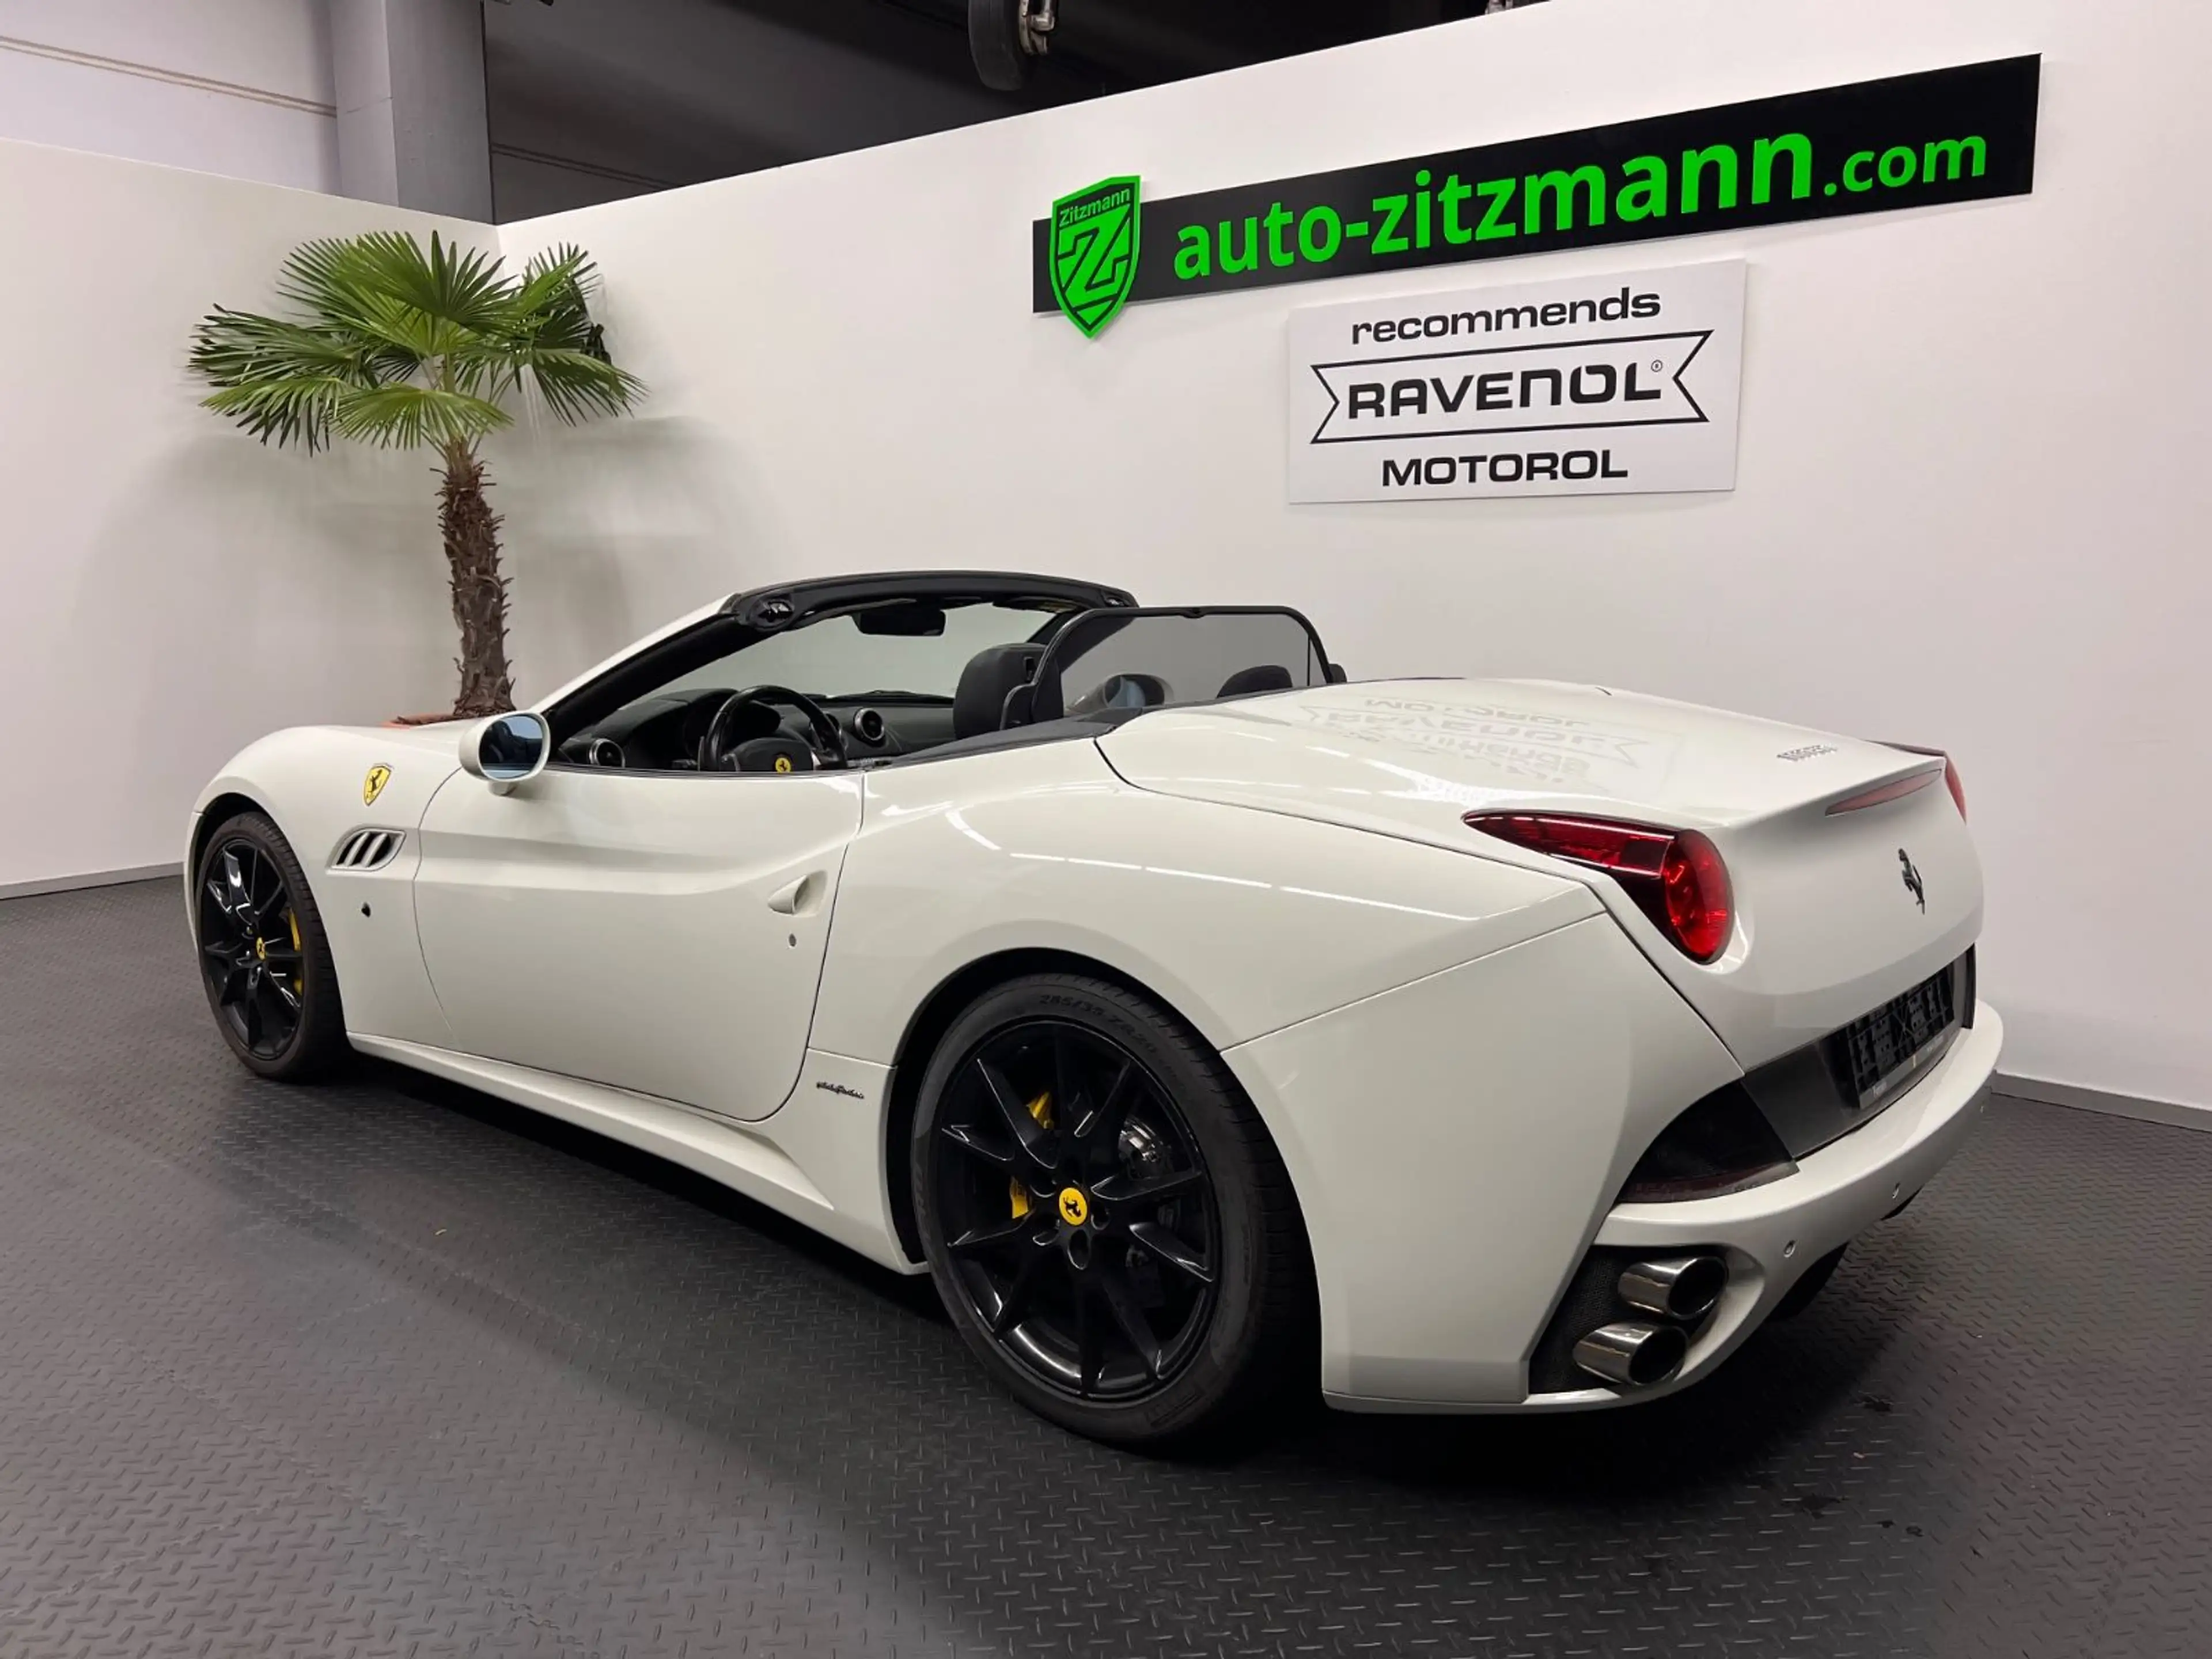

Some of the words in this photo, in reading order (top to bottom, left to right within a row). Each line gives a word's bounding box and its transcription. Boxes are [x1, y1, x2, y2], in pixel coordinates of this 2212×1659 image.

[1059, 188, 1130, 228] Zitzmann
[1173, 132, 1987, 281] auto-zitzmann.com
[1352, 286, 1661, 346] recommends
[1348, 362, 1662, 420] RAVENOL
[1381, 449, 1629, 487] MOTOROL
